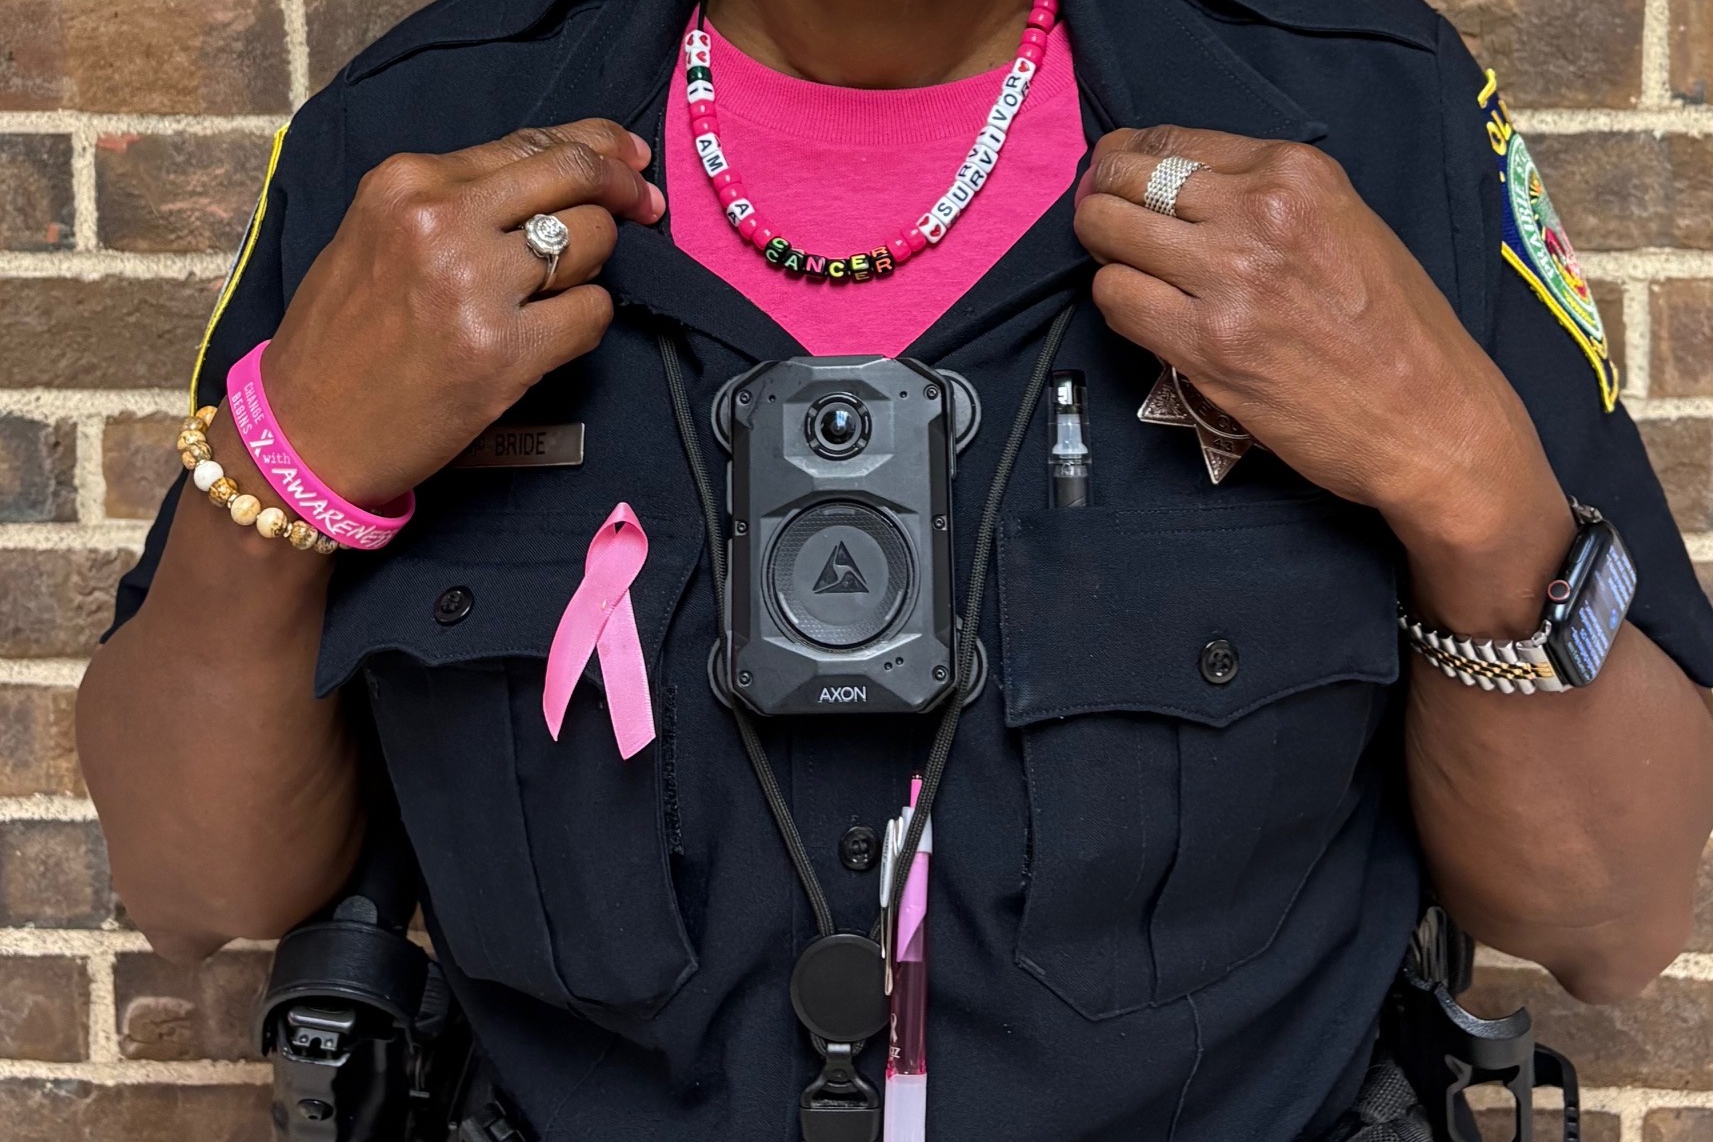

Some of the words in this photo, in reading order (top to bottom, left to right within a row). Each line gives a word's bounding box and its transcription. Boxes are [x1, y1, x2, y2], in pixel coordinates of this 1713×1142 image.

[699, 139, 724, 173] AM
[765, 238, 893, 280] CANCER
[937, 75, 1025, 217] SURVIVOR
[231, 391, 253, 435] BEGINS
[243, 381, 265, 425] CHANGE
[262, 452, 292, 464] with
[494, 431, 547, 456] BRIDE
[818, 685, 867, 703] AXON
